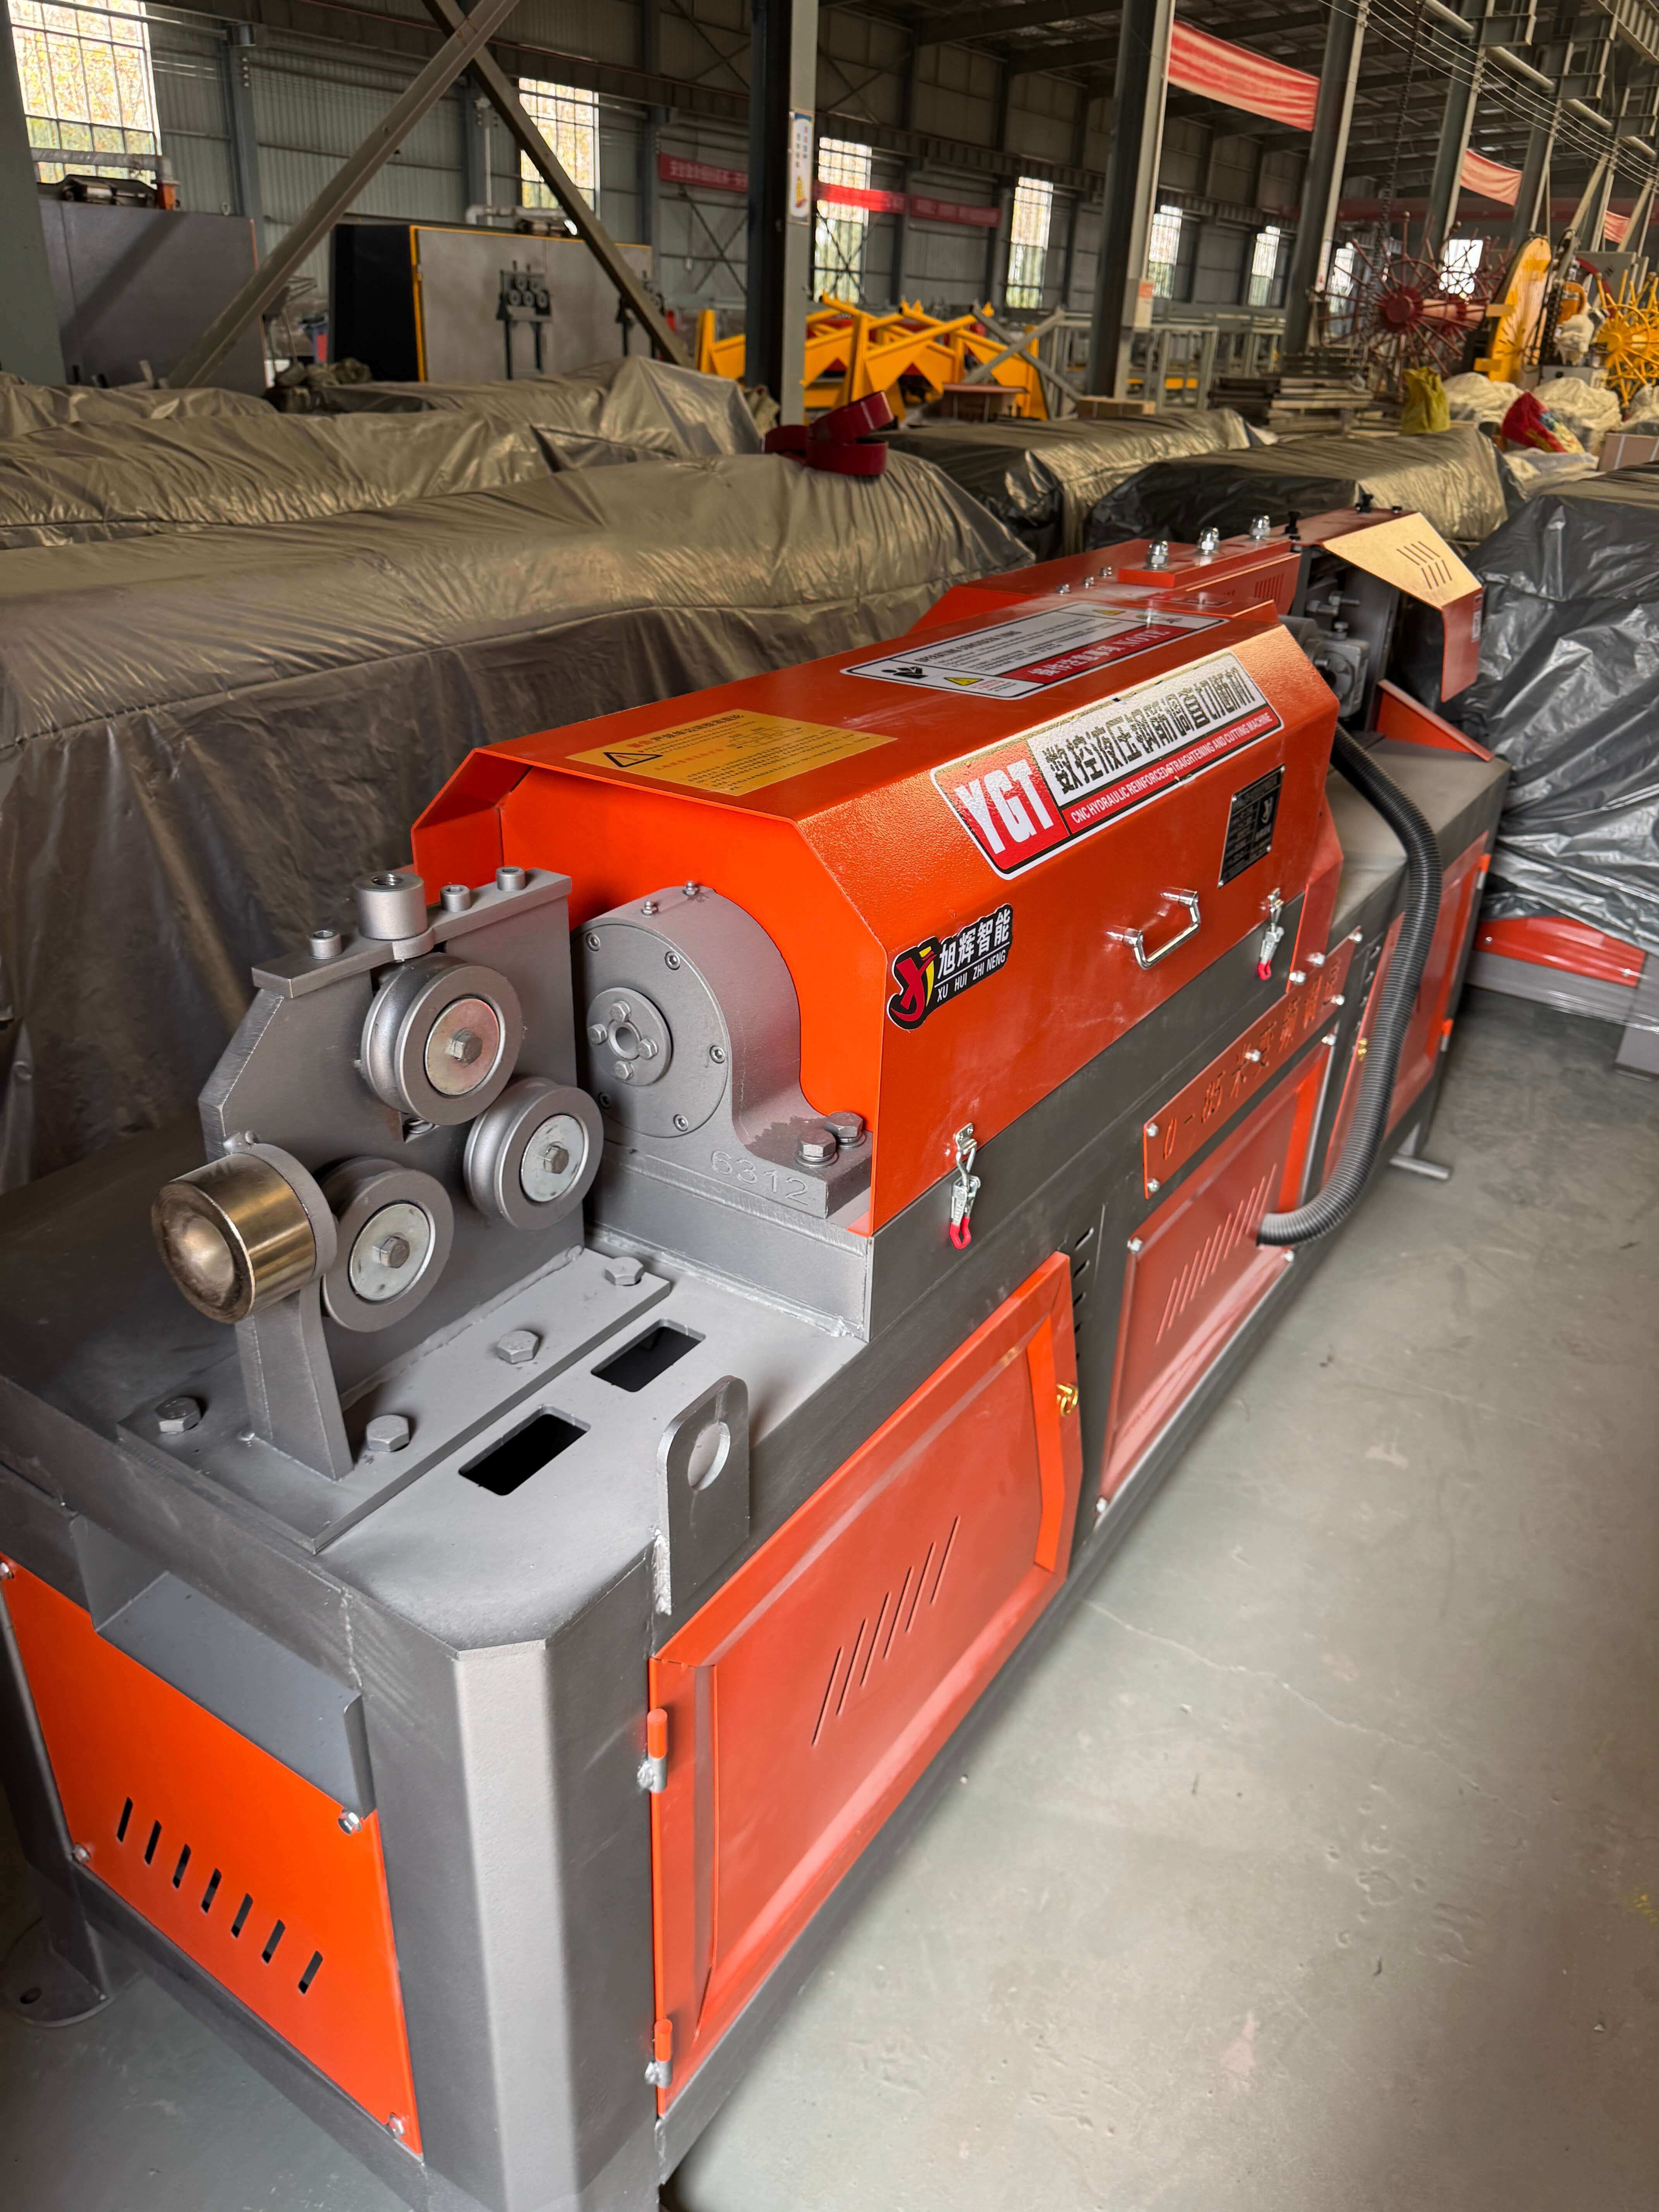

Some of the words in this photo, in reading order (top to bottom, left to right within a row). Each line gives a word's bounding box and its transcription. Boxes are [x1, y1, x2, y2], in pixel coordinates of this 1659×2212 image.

[1042, 667, 1255, 794] 数控液压钢筋调直切断机
[1071, 807, 1090, 824] CNC
[1087, 787, 1130, 816] HYDRAULIC
[1126, 767, 1169, 795] REINFORCED
[1166, 742, 1216, 773] STRAIGHTENING
[1212, 735, 1227, 750] AND
[1224, 724, 1250, 744] CUTTING
[1247, 712, 1273, 732] MACHINE
[954, 759, 1054, 854] YGT
[937, 908, 1011, 979] 旭辉智能
[937, 984, 949, 1003] XU
[954, 972, 968, 992] HUI
[972, 962, 985, 981] ZHI
[986, 949, 1006, 972] NENG
[711, 1150, 809, 1206] 6312
